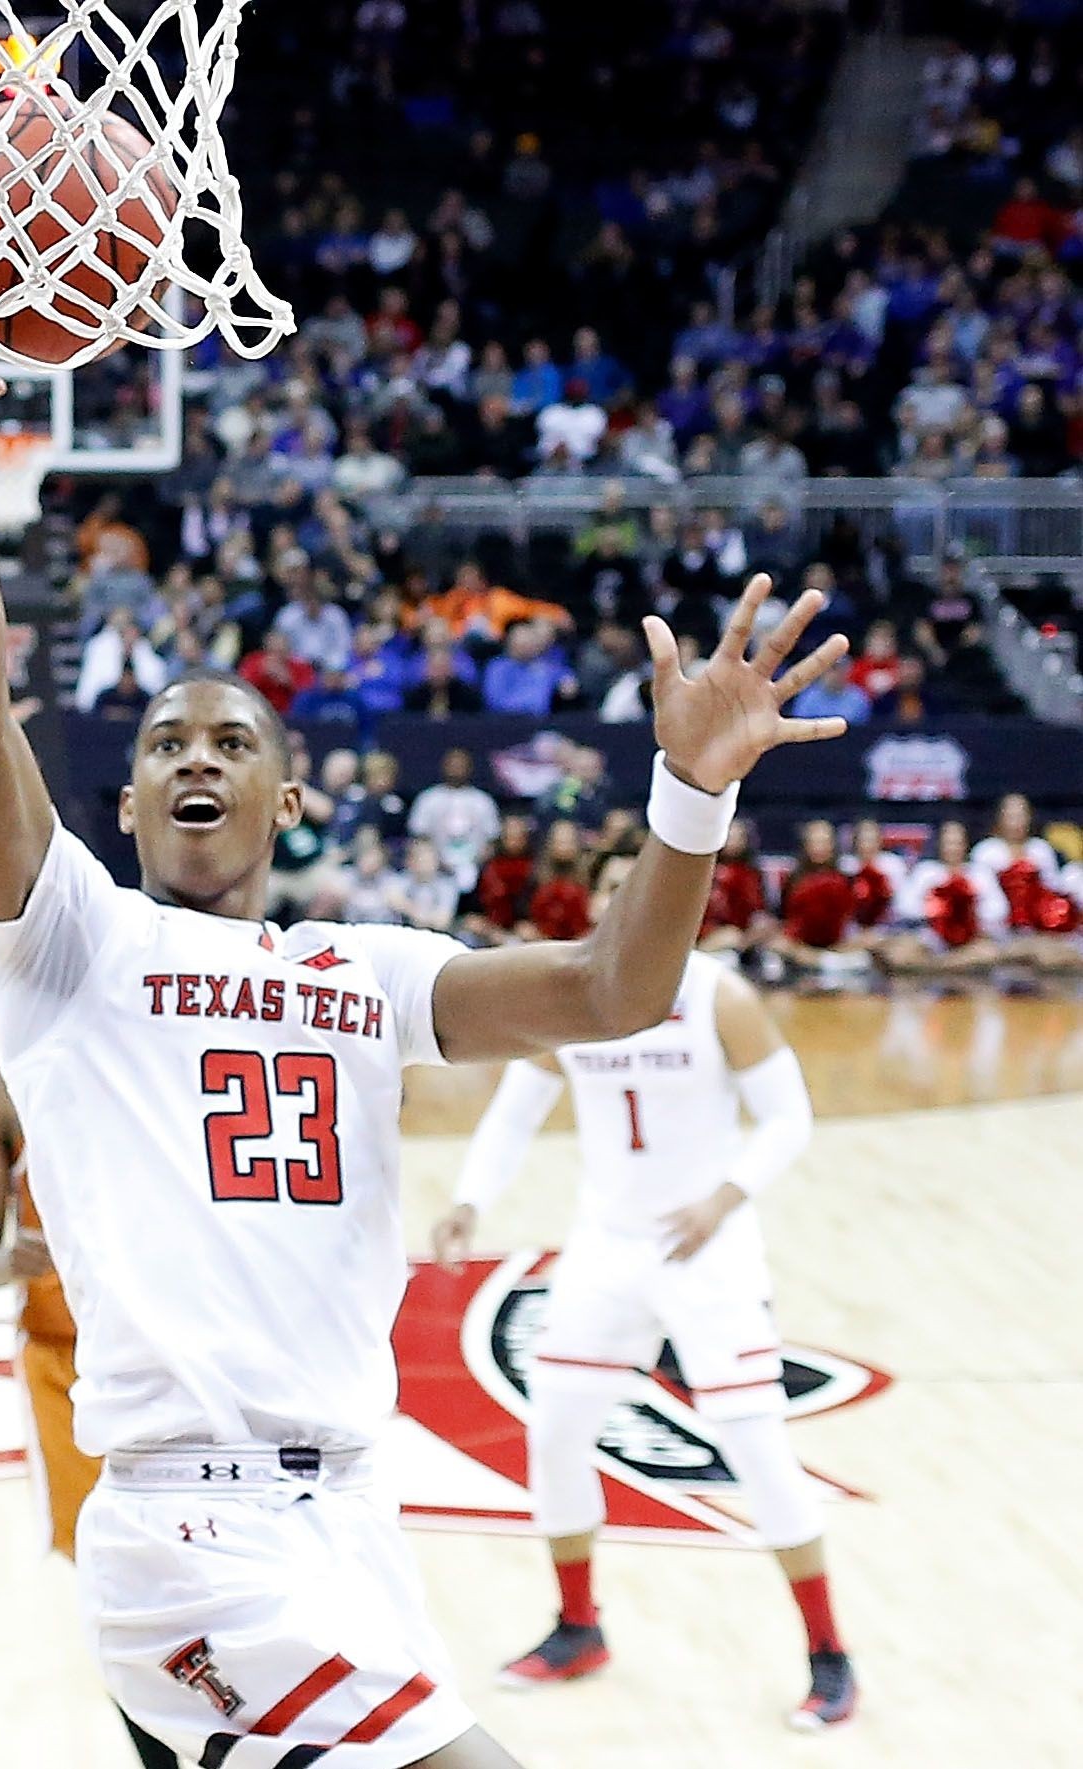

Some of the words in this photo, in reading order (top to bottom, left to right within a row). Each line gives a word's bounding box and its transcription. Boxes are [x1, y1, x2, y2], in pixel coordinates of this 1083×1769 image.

[143, 973, 286, 1022] TEXAS
[296, 982, 384, 1040] TECH
[200, 1048, 344, 1206] 23
[623, 1088, 644, 1151] 1
